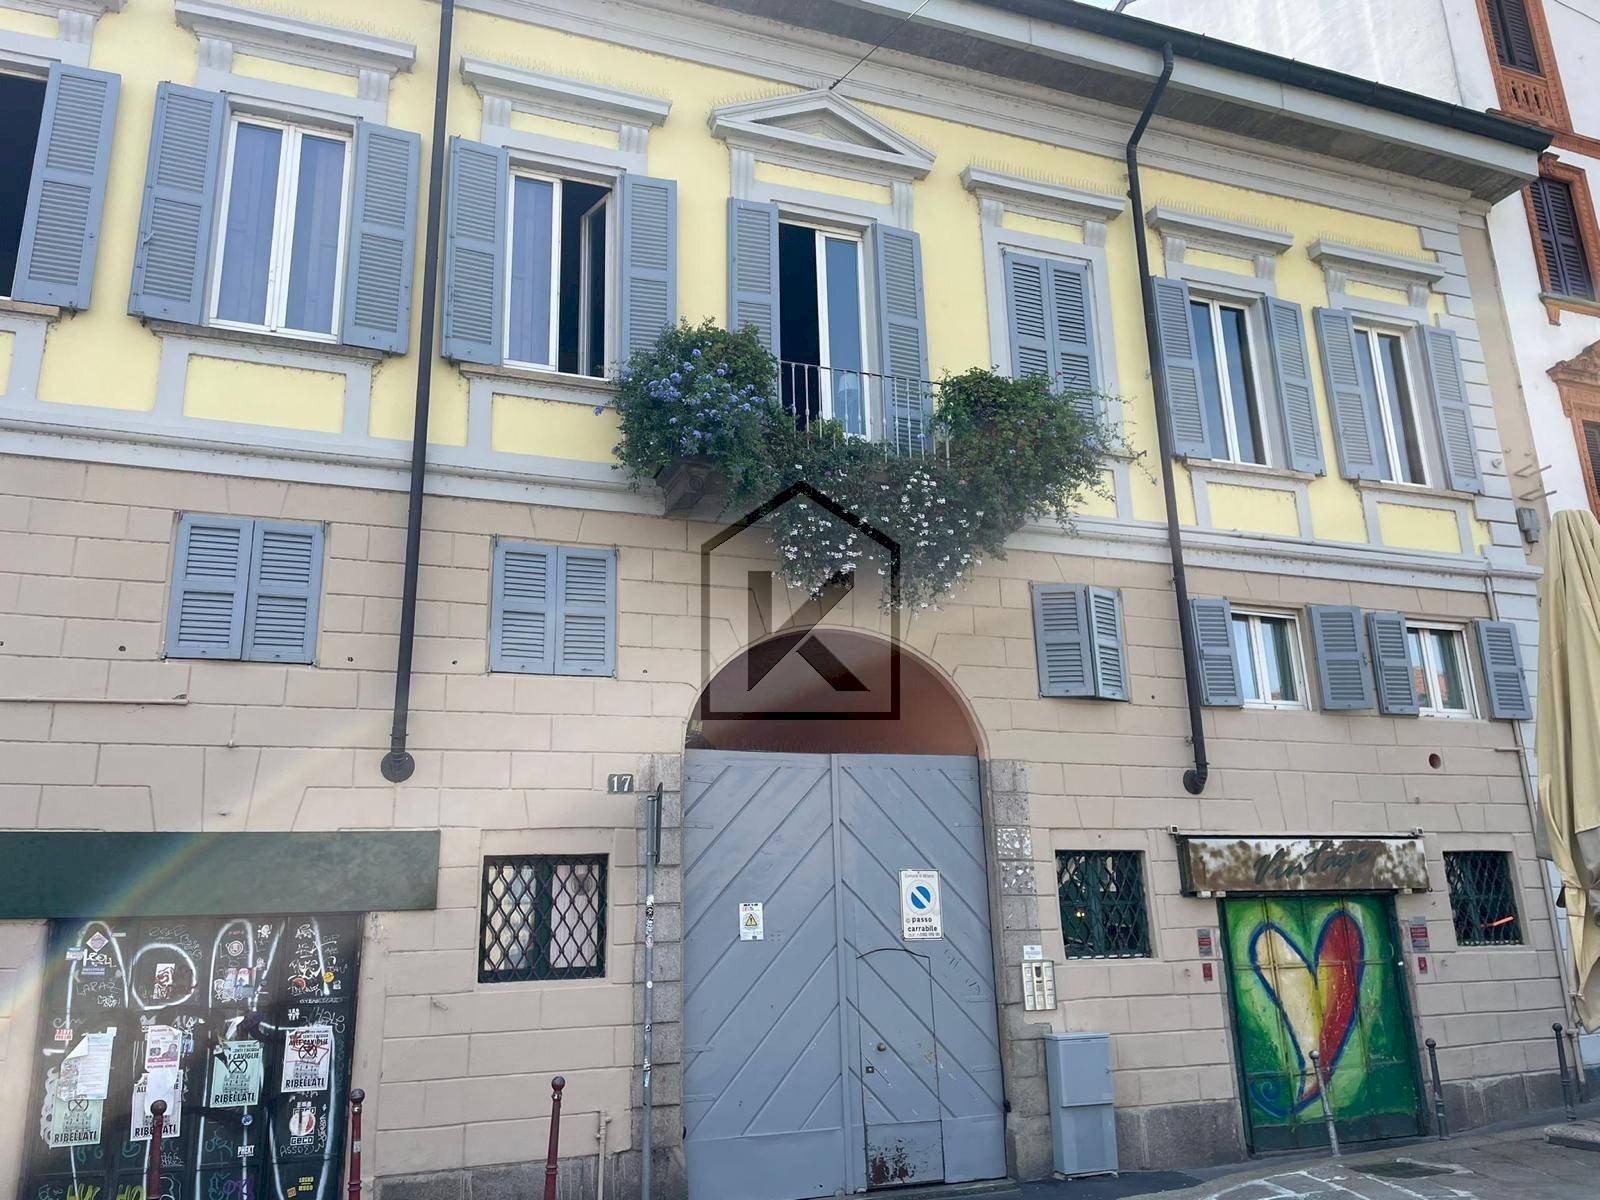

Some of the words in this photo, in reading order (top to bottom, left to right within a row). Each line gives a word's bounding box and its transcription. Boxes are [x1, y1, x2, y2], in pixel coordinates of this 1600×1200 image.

[611, 775, 632, 792] 17
[233, 1052, 260, 1060] CAVIGLIE
[285, 1078, 325, 1088] RIBELLATI
[214, 1093, 255, 1104] RIBELLATI
[54, 1131, 97, 1142] RIBELLATI
